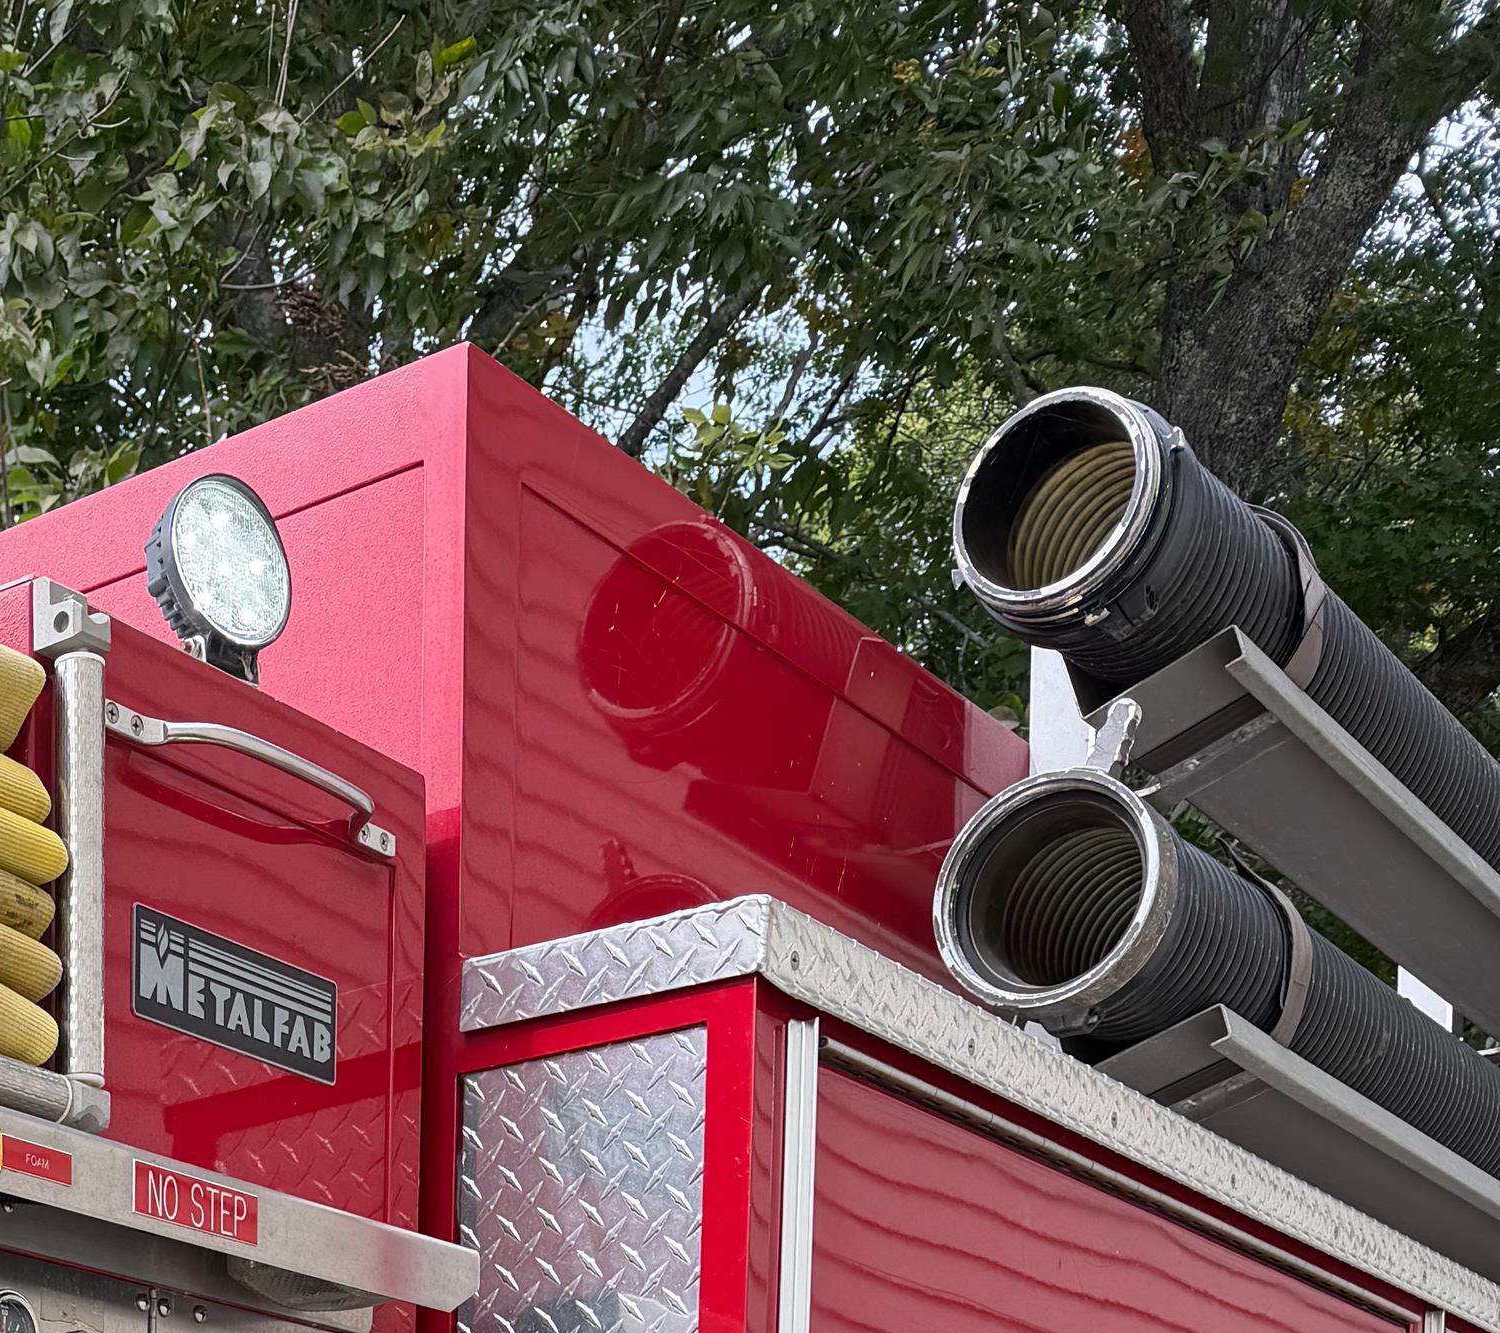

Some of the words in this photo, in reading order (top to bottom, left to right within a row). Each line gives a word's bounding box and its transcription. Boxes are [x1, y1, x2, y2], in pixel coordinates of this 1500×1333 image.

[139, 942, 332, 1064] METALFAB
[25, 1153, 50, 1170] FOAM
[148, 1170, 178, 1219] NO
[191, 1185, 247, 1237] STEP
